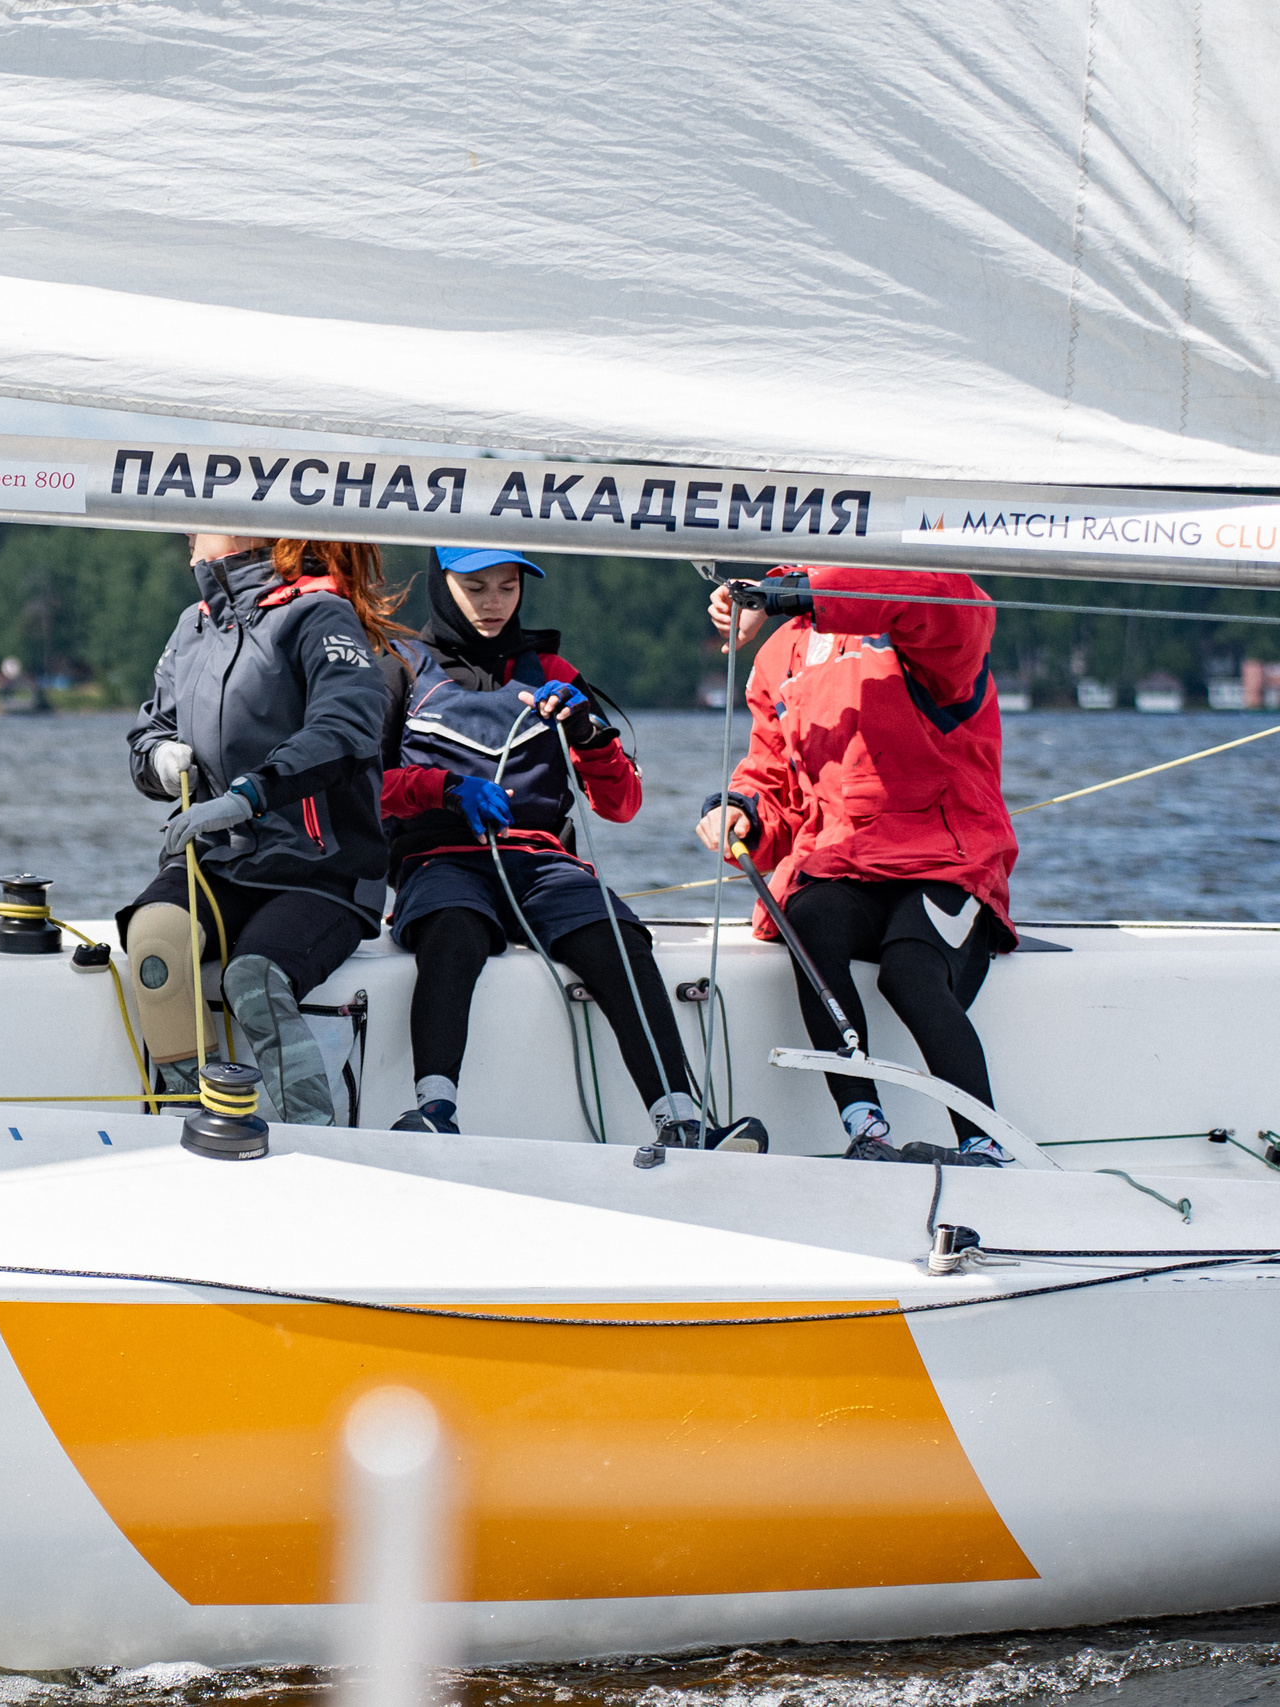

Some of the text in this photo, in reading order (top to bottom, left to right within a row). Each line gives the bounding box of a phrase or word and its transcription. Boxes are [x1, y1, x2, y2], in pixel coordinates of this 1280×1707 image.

[35, 471, 75, 490] 800
[111, 449, 871, 537] ПАРУСНАЯ АКАДЕМИЯ
[961, 510, 1070, 539] MATCH
[1081, 516, 1202, 546] RACING
